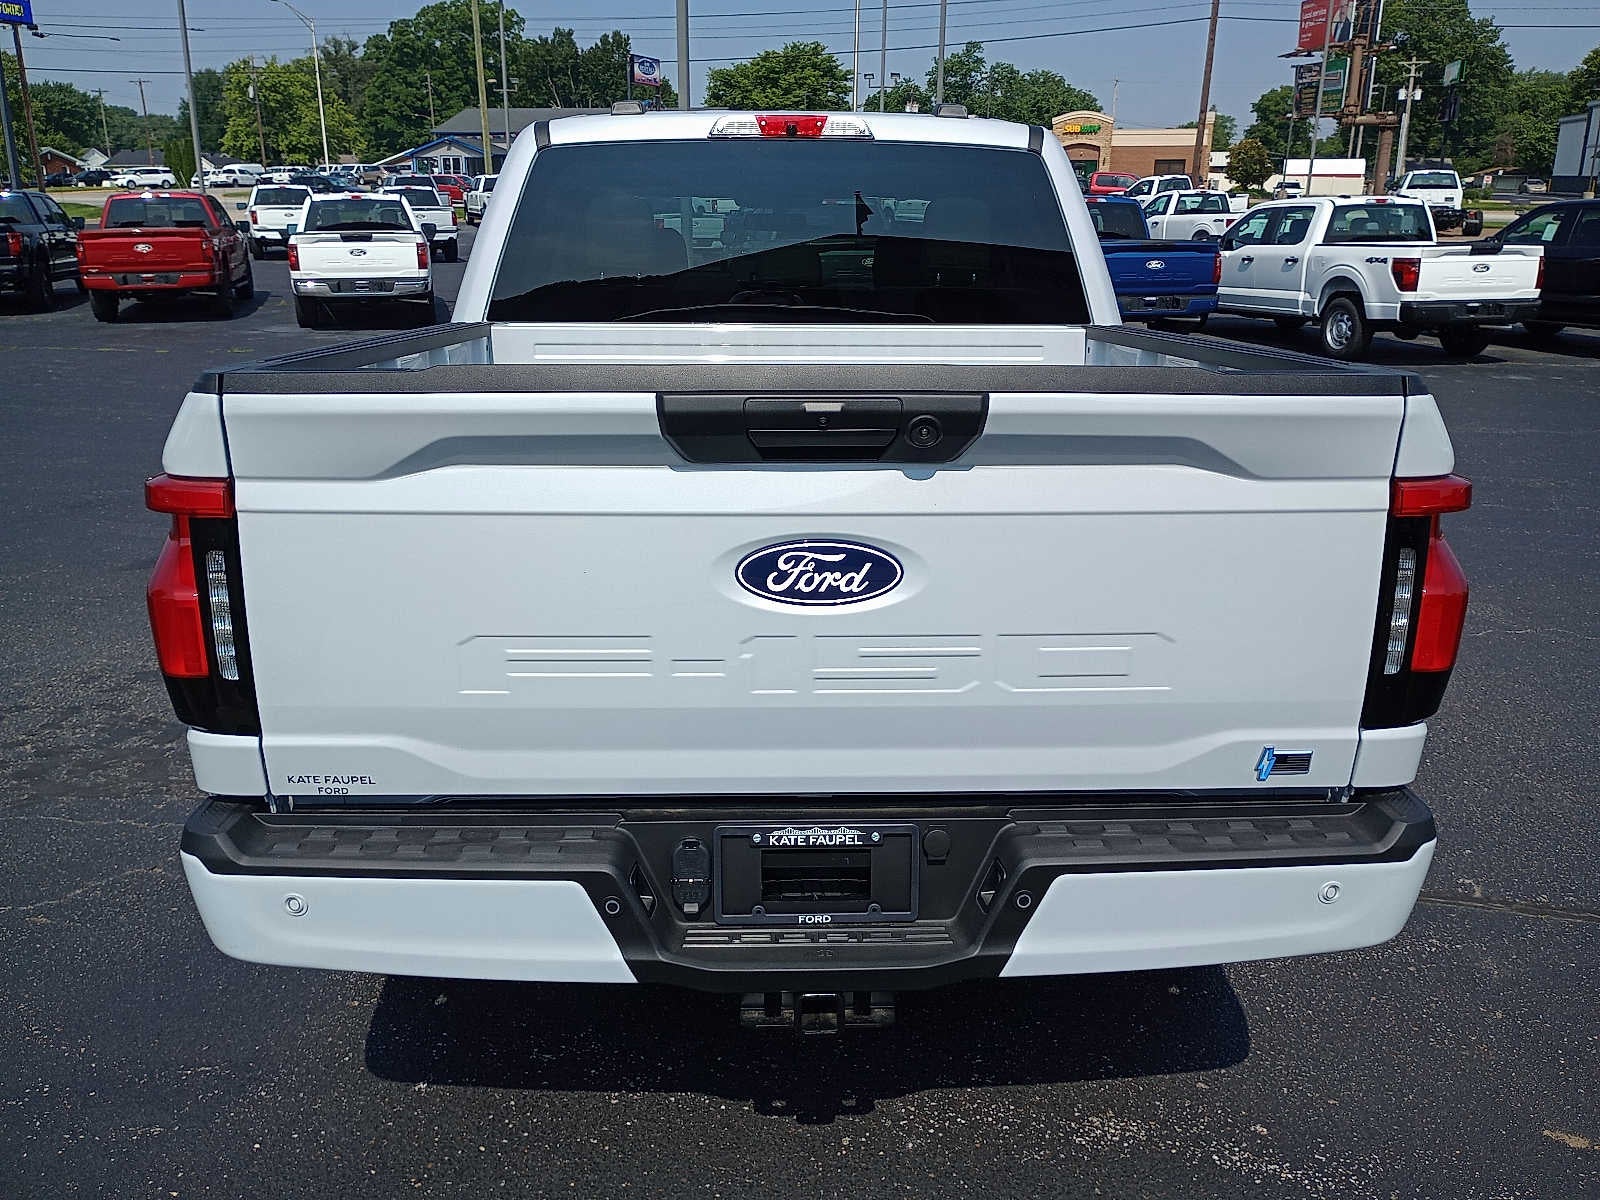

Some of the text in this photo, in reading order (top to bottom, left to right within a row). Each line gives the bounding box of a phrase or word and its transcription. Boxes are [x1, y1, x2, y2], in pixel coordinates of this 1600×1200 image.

[766, 551, 873, 593] Ford
[287, 775, 376, 785] KATE FAUPEL
[318, 787, 349, 795] FORD
[769, 834, 863, 846] KATE FAUPEL
[798, 915, 832, 924] FORD
